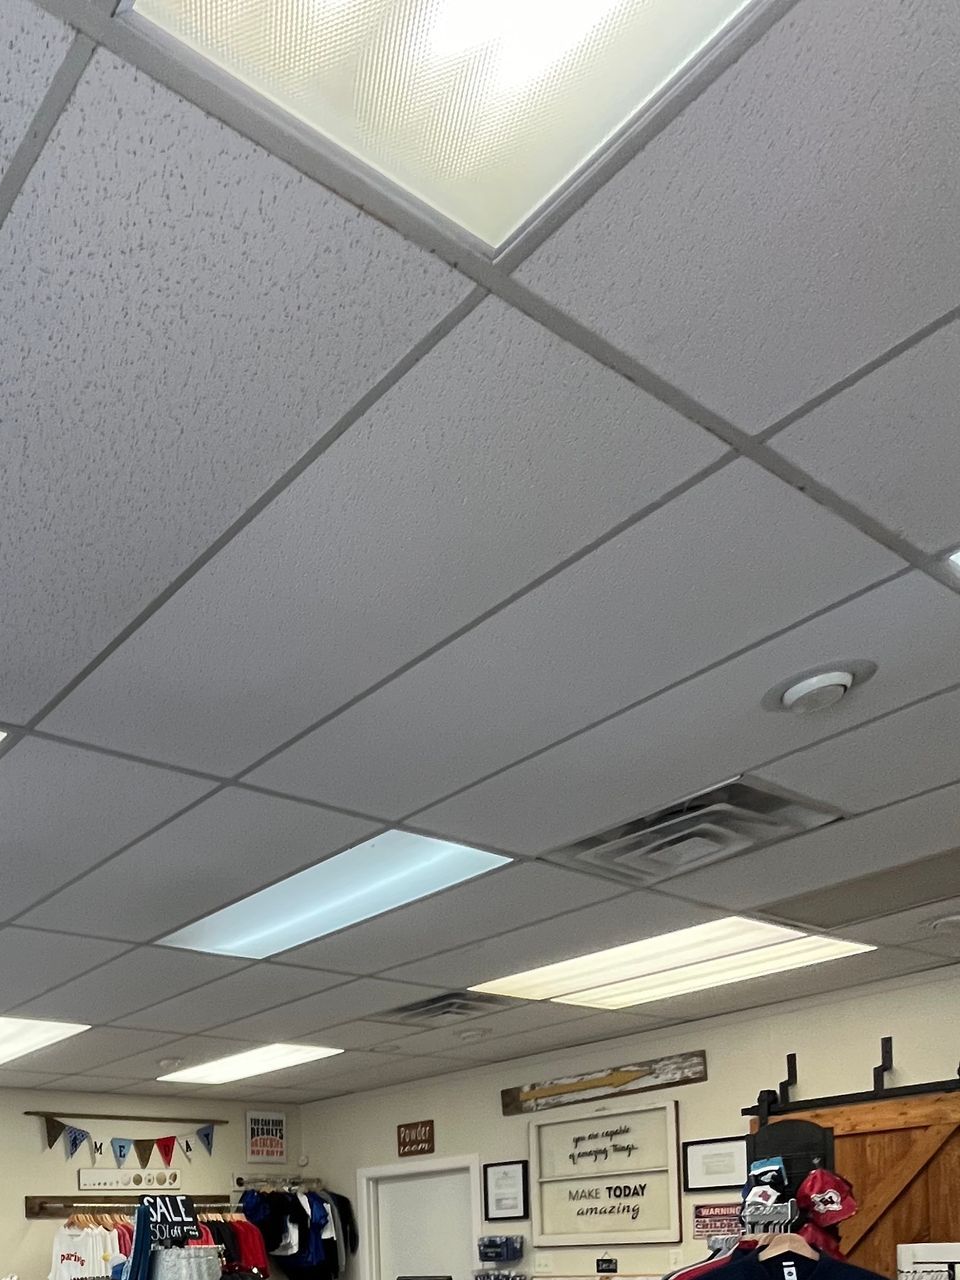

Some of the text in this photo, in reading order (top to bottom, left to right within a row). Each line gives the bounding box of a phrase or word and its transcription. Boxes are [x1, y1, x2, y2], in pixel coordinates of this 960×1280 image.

[250, 1126, 284, 1140] RESULTS
[399, 1142, 432, 1154] room
[576, 1146, 609, 1163] amazing
[568, 1183, 648, 1202] MAKE TODAY
[143, 1195, 194, 1223] SALE
[576, 1203, 641, 1220] amazing
[695, 1222, 742, 1230] CHILDRE
